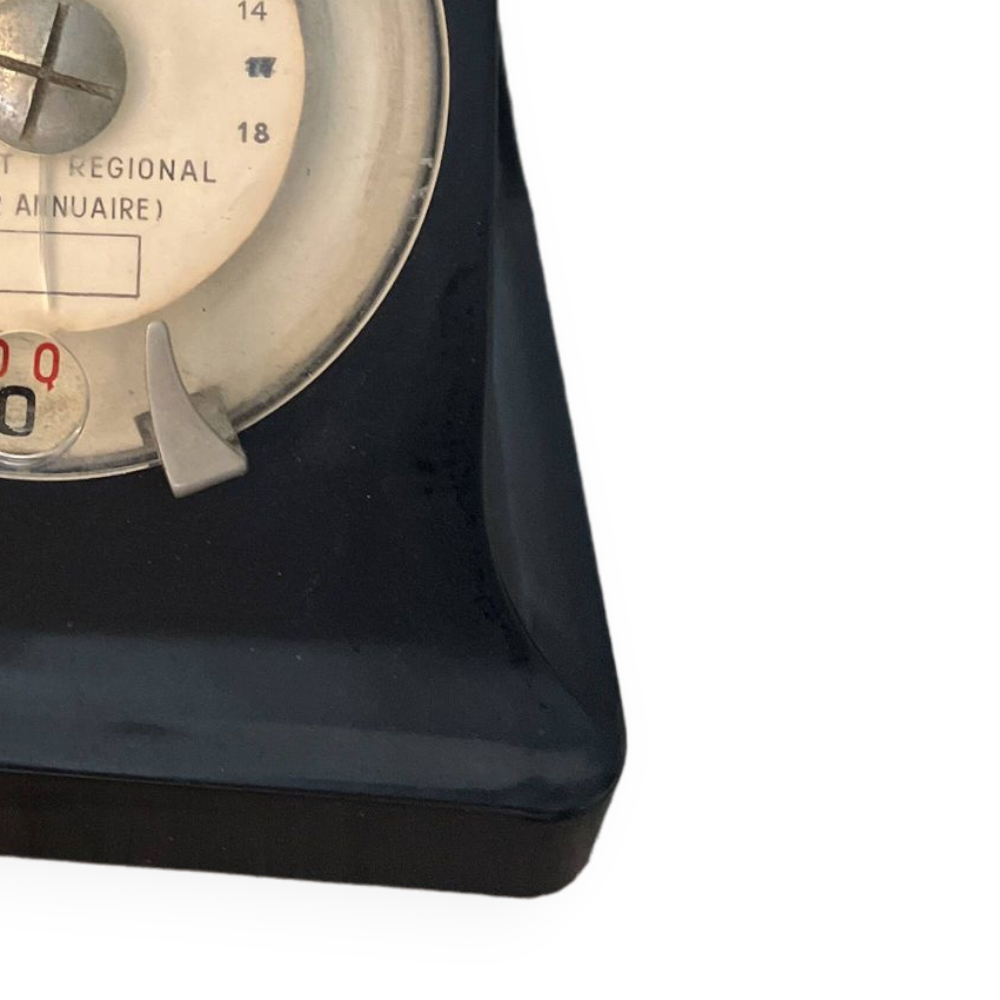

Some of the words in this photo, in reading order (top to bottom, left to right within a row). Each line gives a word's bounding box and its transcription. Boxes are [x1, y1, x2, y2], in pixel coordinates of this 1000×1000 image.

[238, 0, 267, 21] 14
[237, 121, 270, 144] 18
[68, 155, 218, 184] REGIONAL
